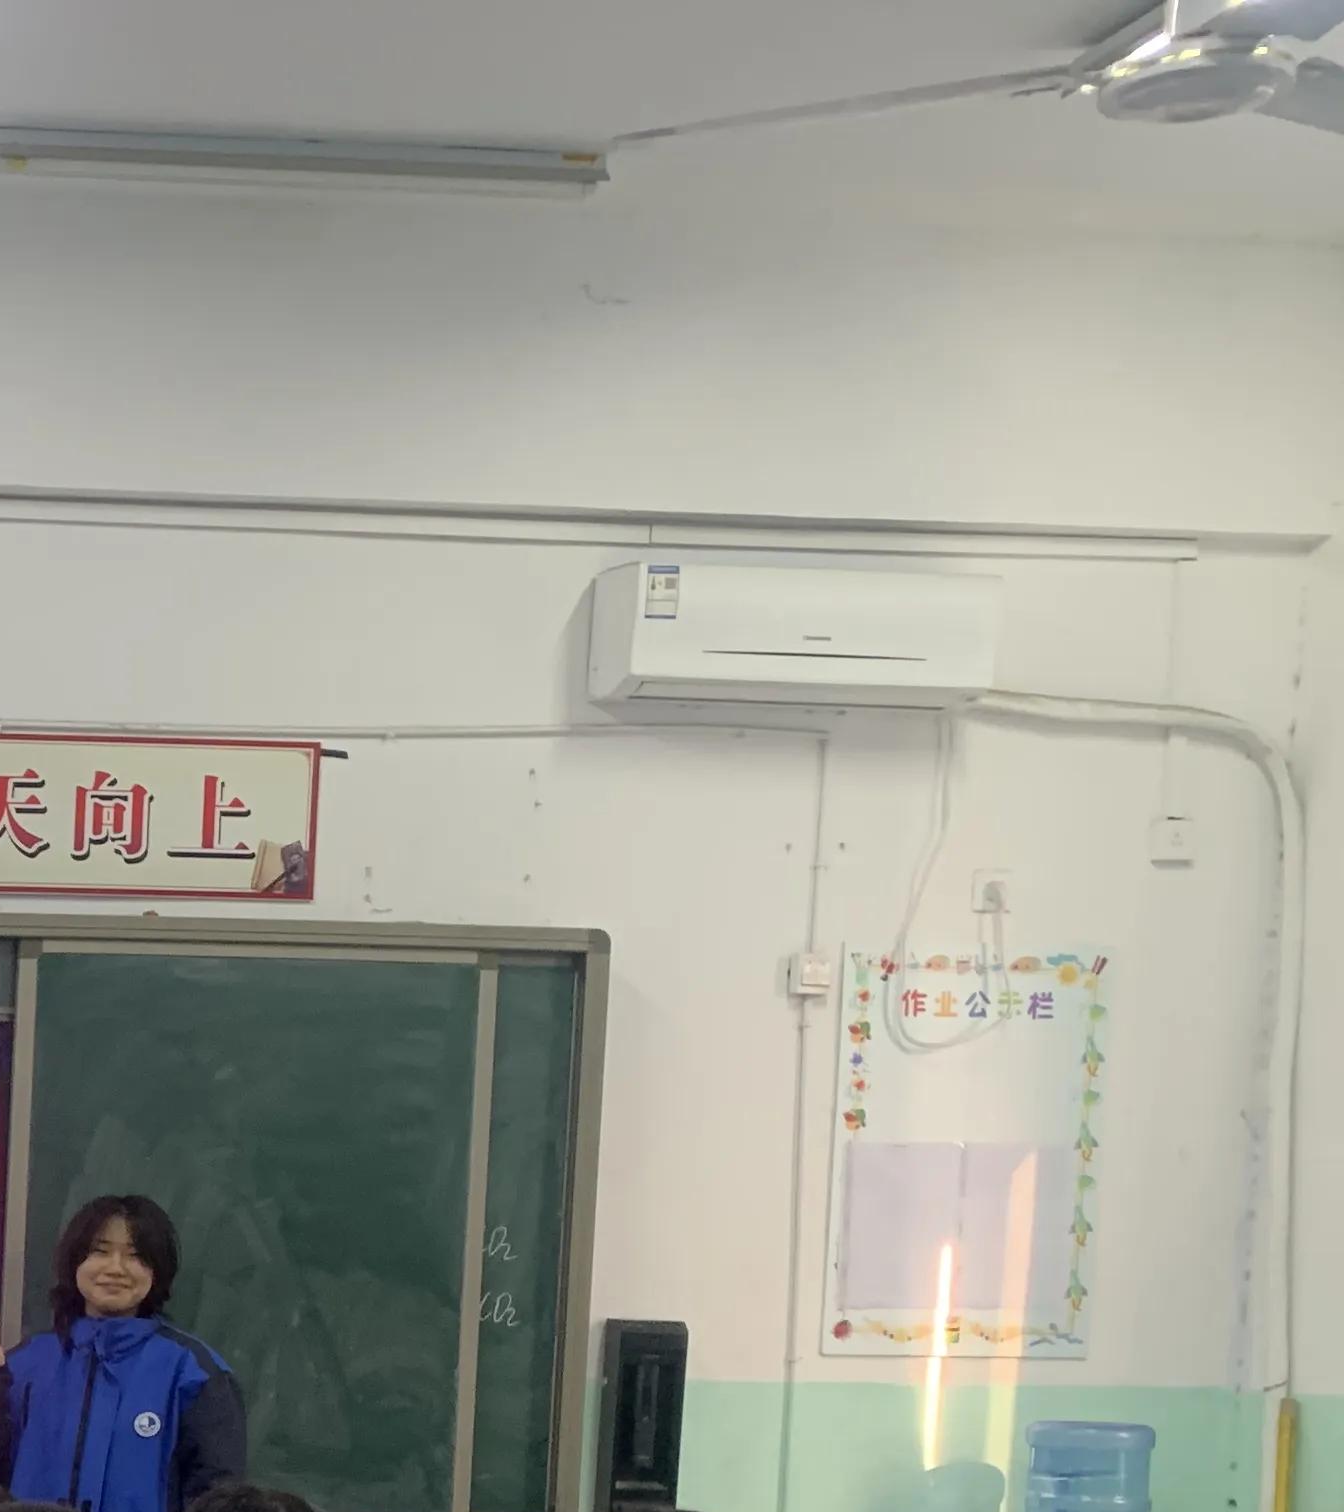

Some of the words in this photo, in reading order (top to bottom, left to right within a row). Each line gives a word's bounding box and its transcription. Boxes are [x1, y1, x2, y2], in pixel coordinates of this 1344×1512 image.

[901, 989, 1054, 1020] 作业公示栏
